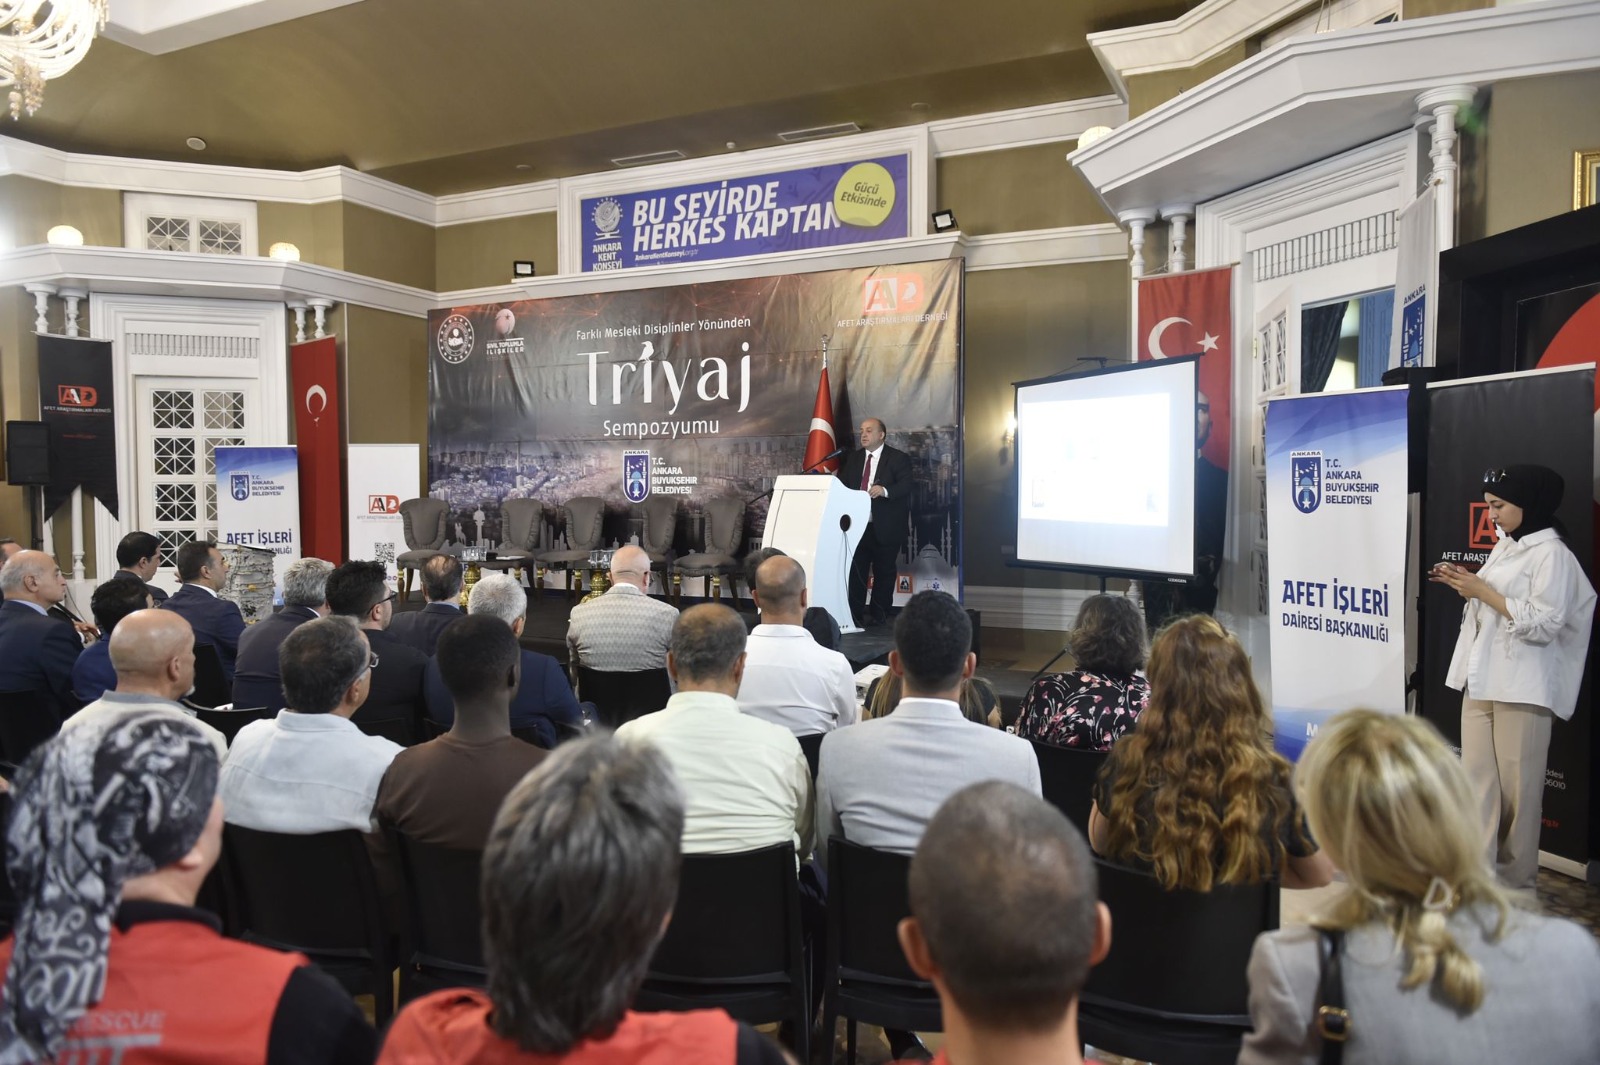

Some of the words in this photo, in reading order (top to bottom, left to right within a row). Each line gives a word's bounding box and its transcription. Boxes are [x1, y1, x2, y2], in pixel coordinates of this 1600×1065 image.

[854, 182, 879, 195] Gücü
[633, 197, 666, 226] BU
[673, 181, 779, 222] SEYİRDE
[841, 192, 887, 208] Etkisinde
[633, 215, 726, 252] HERKES
[734, 201, 841, 240] KAPTAN
[592, 242, 622, 253] ANKARA
[598, 252, 617, 262] KENT
[1403, 284, 1426, 304] ANKARA
[576, 330, 602, 341] Farklı
[604, 325, 641, 338] Mesleki
[644, 321, 695, 337] Disiplinler
[698, 317, 751, 331] Yönünden
[837, 319, 854, 328] AFET
[603, 420, 719, 439] Sempozyumu
[652, 457, 665, 465] T.C.
[1325, 459, 1341, 468] T.C.
[652, 467, 683, 475] ANKARA
[1325, 471, 1362, 480] ANKARA
[226, 532, 254, 545] AFET
[258, 528, 292, 545] İŞLERİ
[1441, 551, 1462, 561] AFET
[1282, 580, 1327, 608] AFET
[1333, 577, 1389, 617] İŞLERİ
[1282, 611, 1322, 631] DAİRESİ
[1325, 618, 1389, 643] BAŞKANLIĞI
